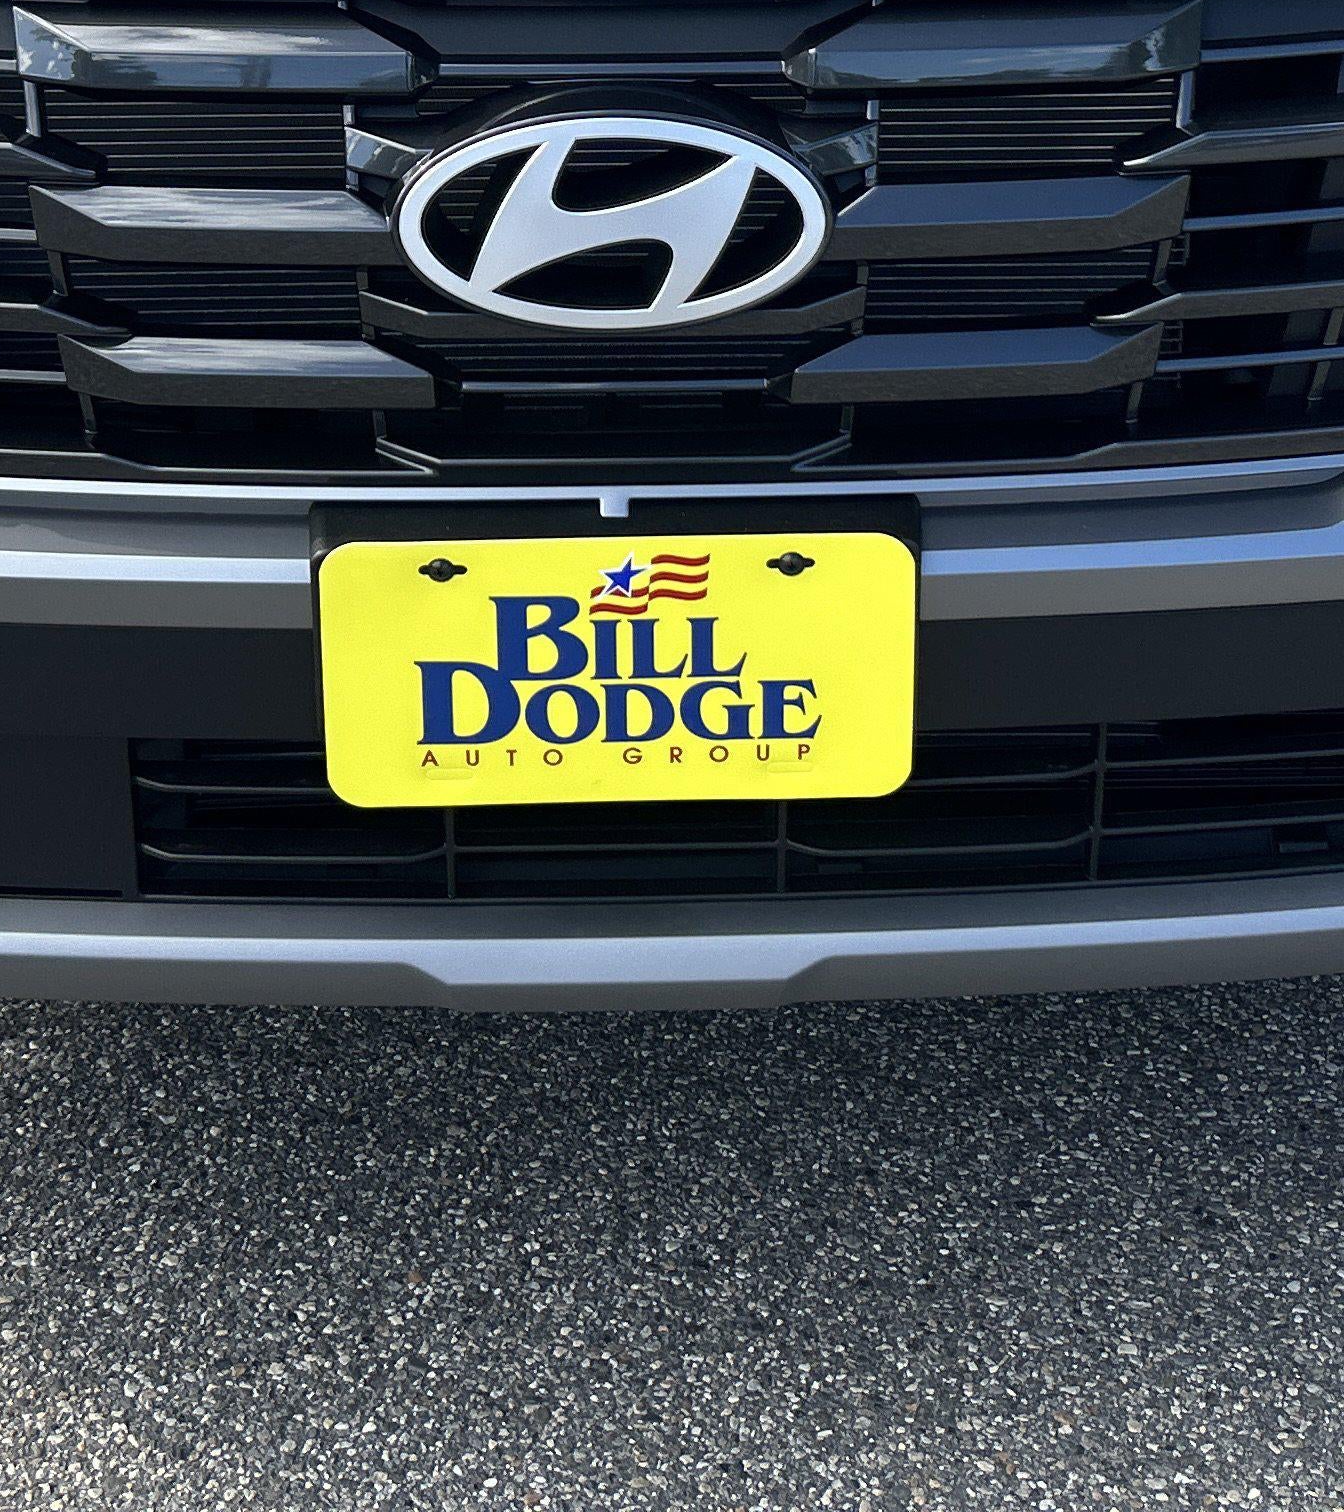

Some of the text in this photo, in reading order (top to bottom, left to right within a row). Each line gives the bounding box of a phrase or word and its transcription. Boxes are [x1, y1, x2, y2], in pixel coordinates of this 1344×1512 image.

[488, 595, 747, 681] BILL
[414, 659, 821, 746] DODGE
[421, 743, 812, 768] AUTO GROUP
